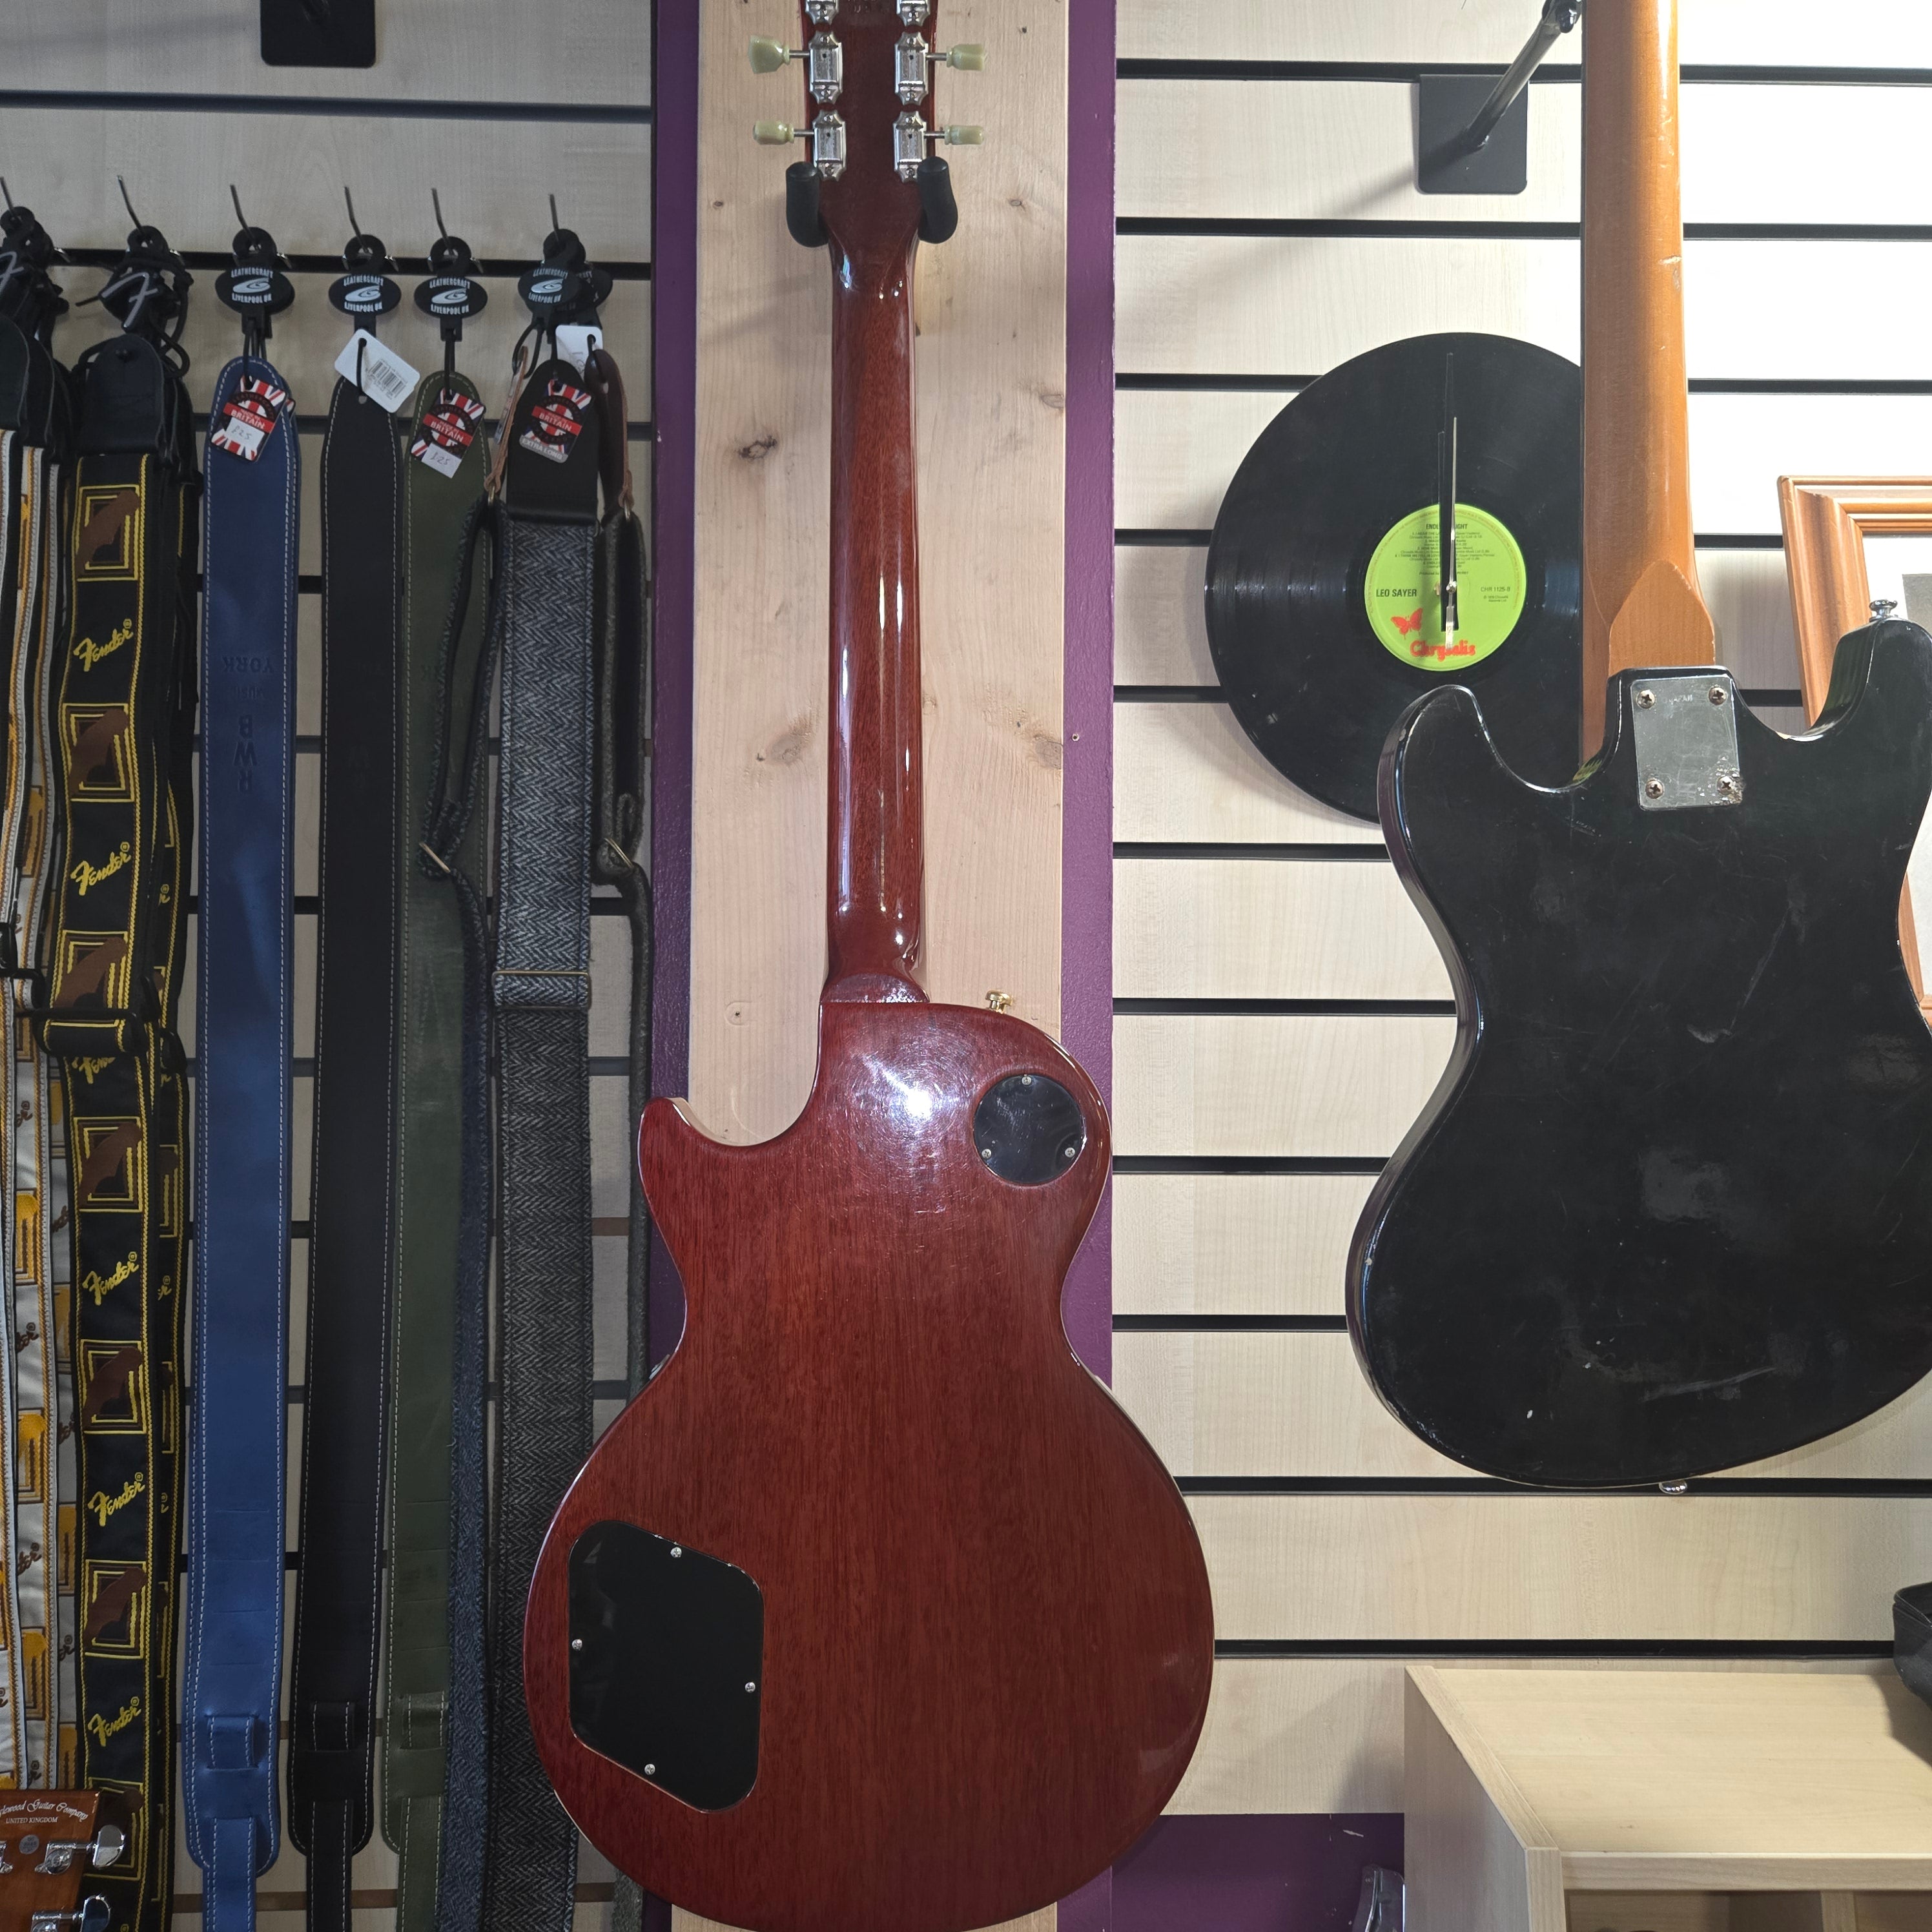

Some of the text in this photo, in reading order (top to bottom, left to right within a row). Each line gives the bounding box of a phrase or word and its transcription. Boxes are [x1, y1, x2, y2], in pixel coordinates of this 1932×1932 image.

[231, 267, 273, 278] LEATHERCRAFT
[344, 274, 384, 286] LEATHERCRAFT
[429, 278, 470, 289] LEATHERCRAFT
[232, 293, 263, 303] LIVERPOOL
[344, 302, 374, 312] LIVERPOOL
[430, 303, 461, 314] LIVERPOOL
[231, 409, 265, 429] BRITAIN
[539, 412, 572, 431] BRITAIN
[430, 421, 464, 442] BRITAIN
[522, 438, 563, 460] EXTRA LONG
[1376, 589, 1417, 597] LEO SAYER
[27, 1798, 56, 1813] Guitar
[56, 1802, 88, 1822] Company
